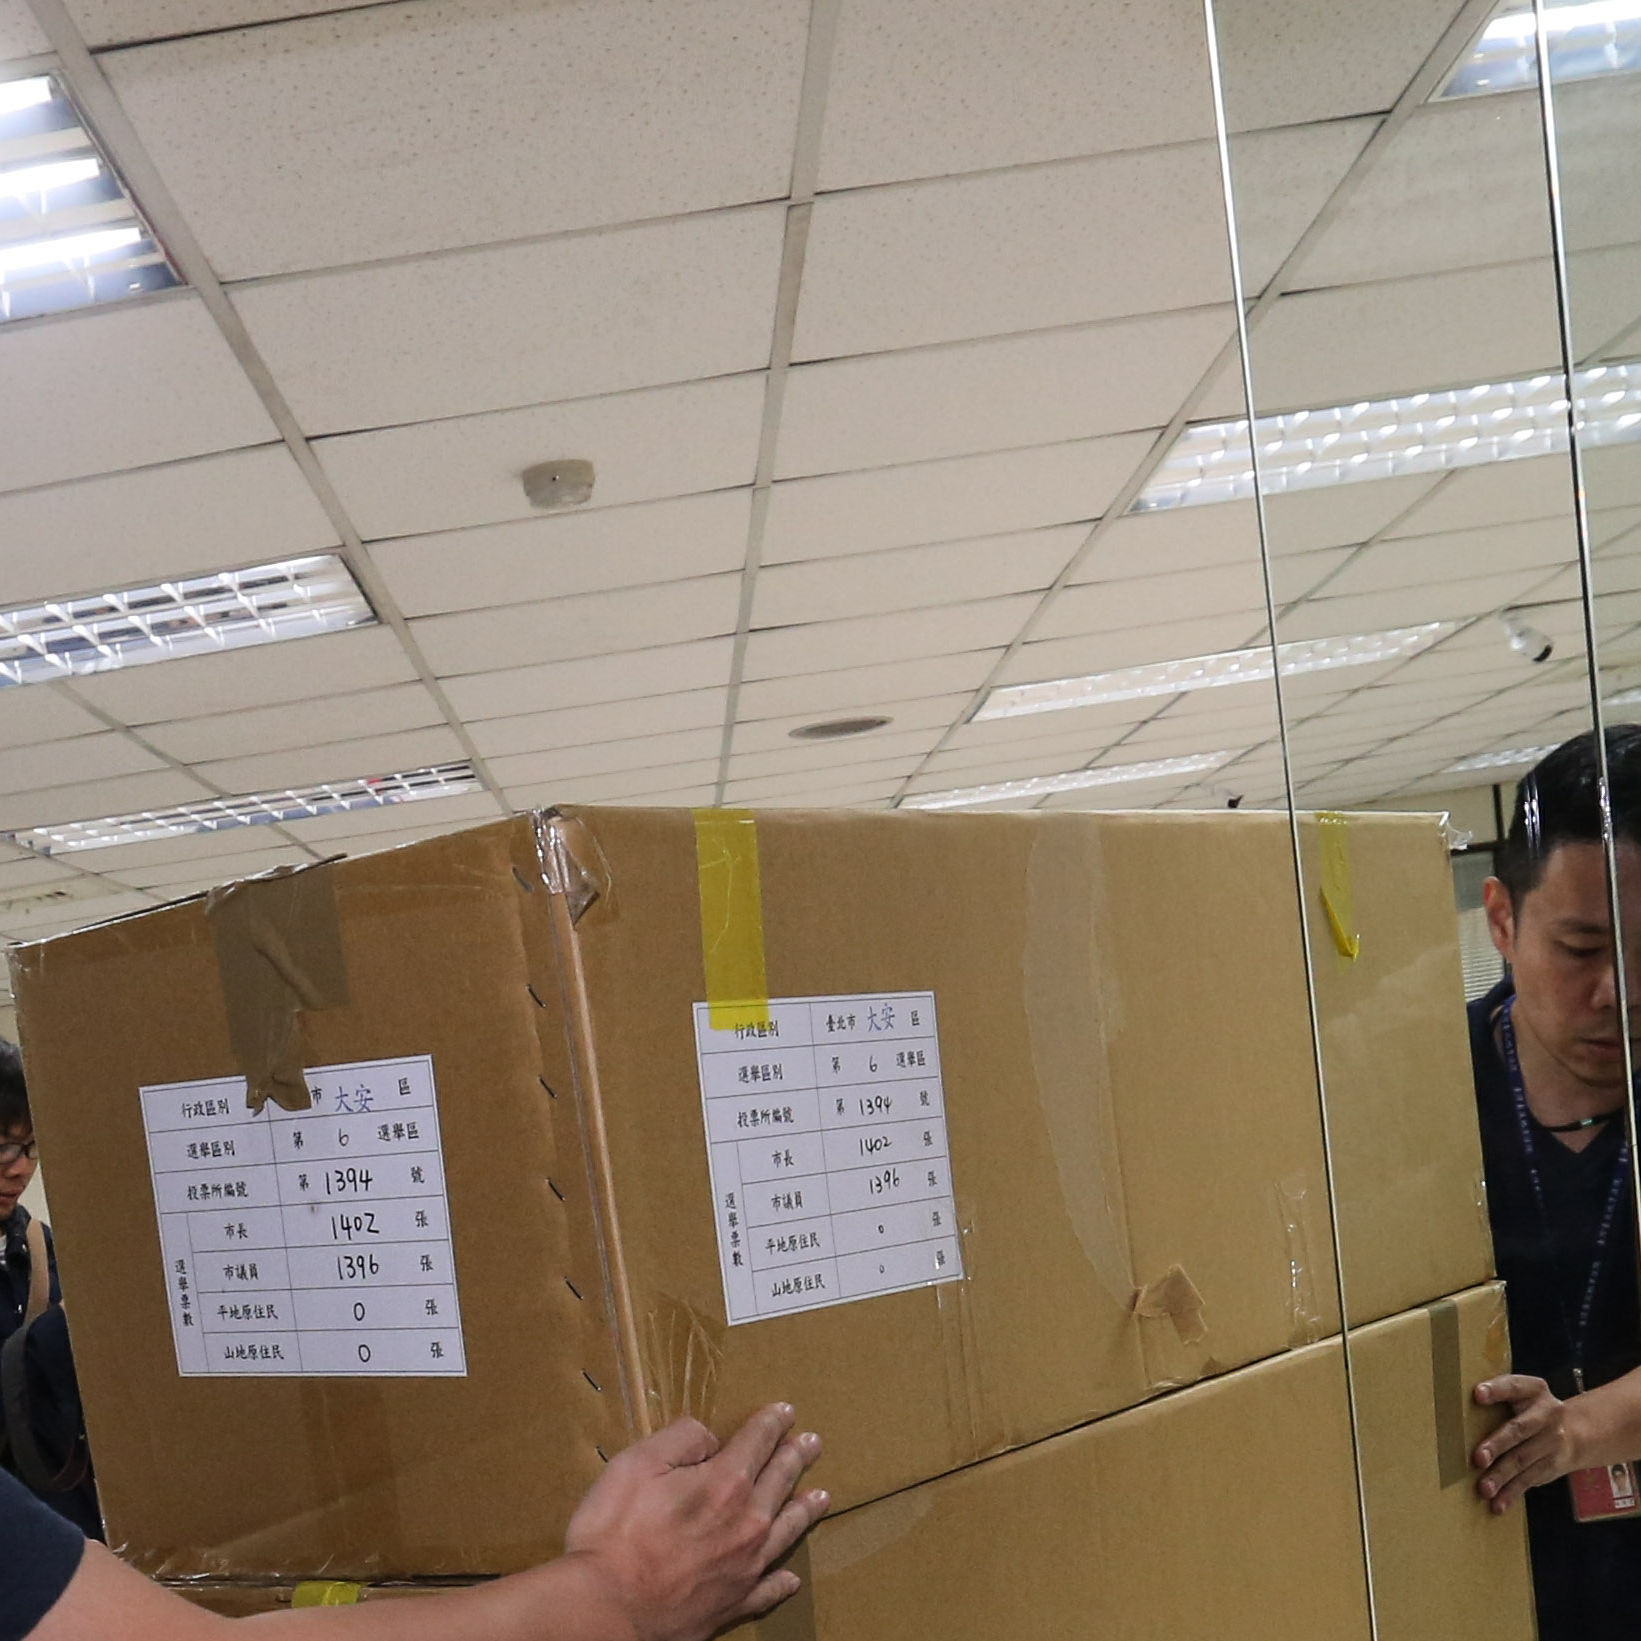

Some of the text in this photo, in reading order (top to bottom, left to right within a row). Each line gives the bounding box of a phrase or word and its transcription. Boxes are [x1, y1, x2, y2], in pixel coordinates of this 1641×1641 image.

[825, 1013, 854, 1031] 臺北市
[738, 1063, 782, 1082] 選舉區別
[868, 1055, 876, 1071] 6
[895, 1049, 924, 1067] 選舉區
[181, 1097, 228, 1118] 行政區別
[334, 1085, 374, 1113] 大安
[397, 1076, 410, 1095] 區
[737, 1105, 793, 1127] 投票所編號
[859, 1094, 891, 1114] 1394
[186, 1139, 234, 1158] 選舉區別
[338, 1128, 348, 1145] 6
[377, 1121, 418, 1141] 選舉區
[771, 1148, 793, 1167] 市長
[859, 1135, 891, 1155] 1402
[186, 1180, 247, 1199] 投票所編號
[325, 1167, 372, 1194] 1394
[410, 1165, 424, 1183] 號
[770, 1190, 802, 1211] 市議員
[869, 1167, 898, 1193] 1396
[223, 1209, 428, 1240] 市長 1402 張
[724, 1192, 742, 1266] 選舉票數
[764, 1231, 819, 1254] 平地原住民
[222, 1253, 432, 1280] 市議員 1396 張
[174, 1258, 193, 1325] 選舉票數
[771, 1273, 824, 1296] 山地原住民
[216, 1298, 437, 1320] 平地原住民 0 張
[223, 1341, 443, 1362] 山地原住民 0 張
